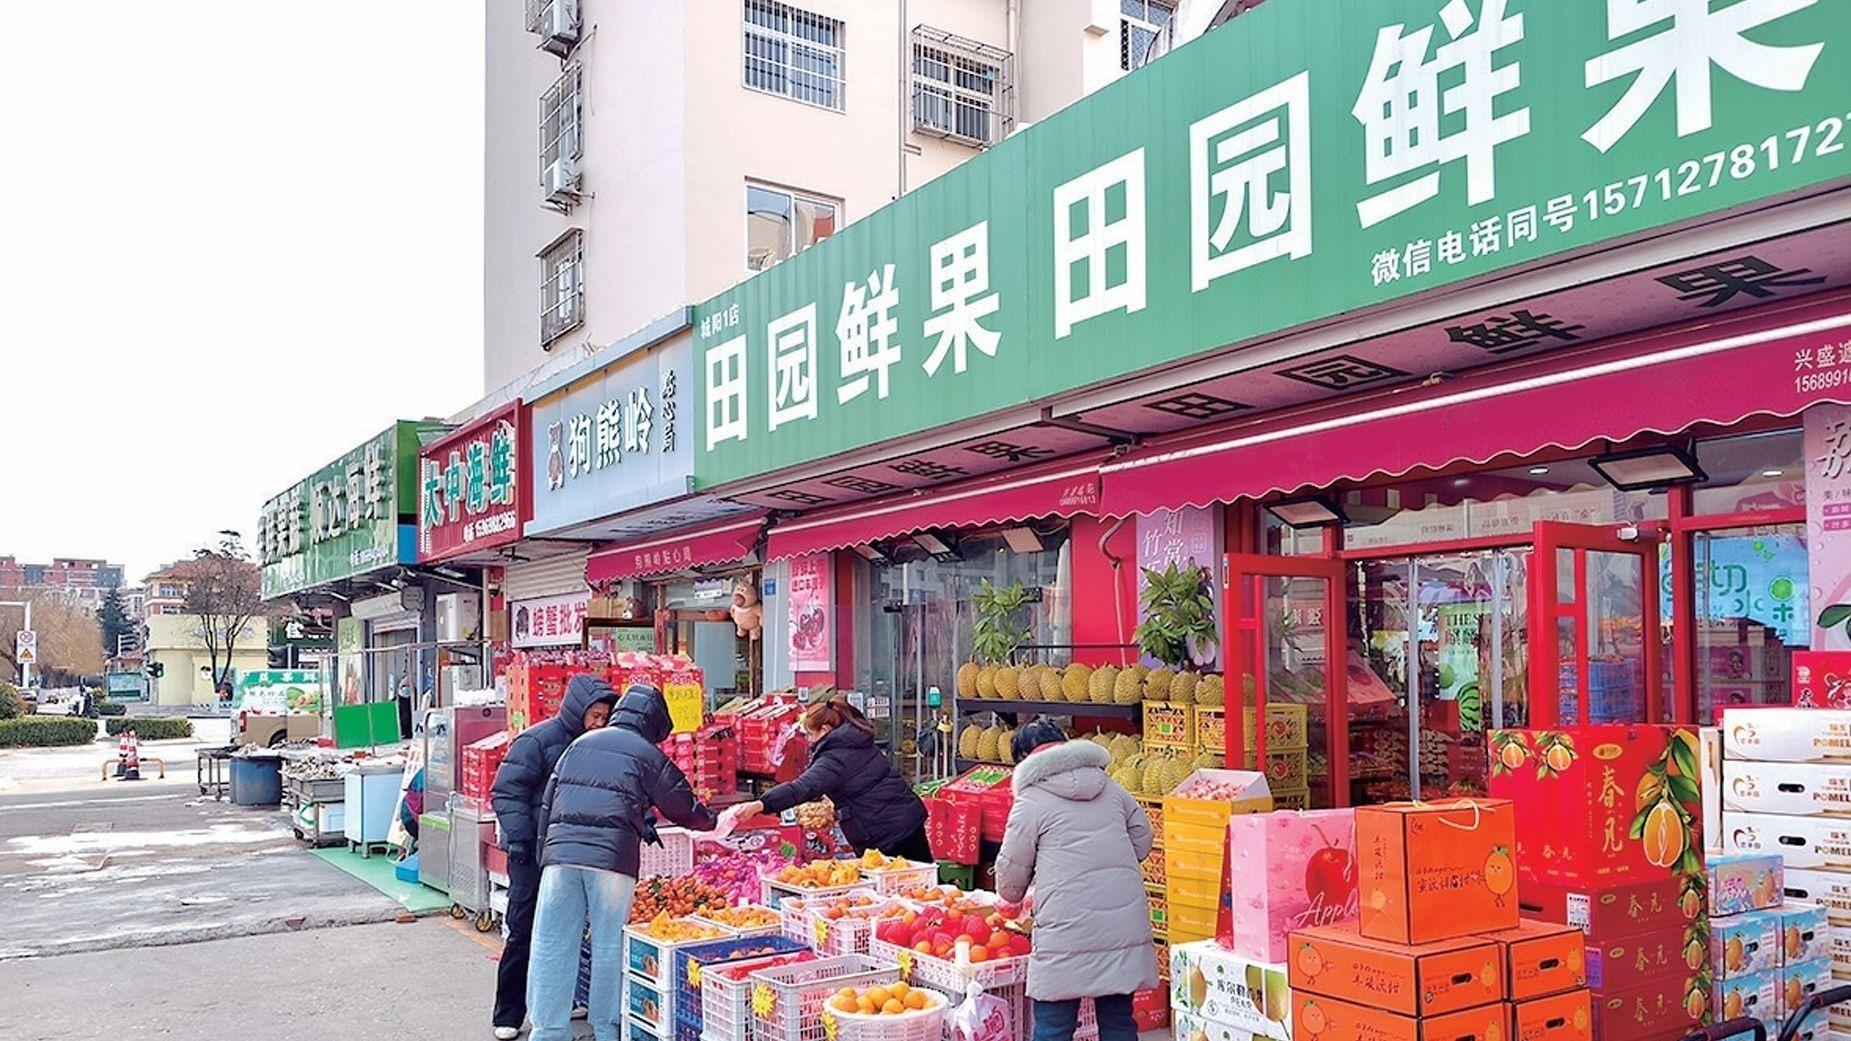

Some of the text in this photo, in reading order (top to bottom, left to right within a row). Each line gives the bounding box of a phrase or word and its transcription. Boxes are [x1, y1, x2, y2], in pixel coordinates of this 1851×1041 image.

[1053, 0, 1826, 340] 田园鲜果
[1371, 113, 1851, 286] 微信电话同号1571278172
[700, 304, 739, 340] 城阳1店
[703, 219, 1002, 450] 田园鲜果
[1143, 256, 1827, 419] 田园鲜果
[1795, 338, 1851, 372] 兴盛遮
[424, 420, 514, 528] 大中海鲜
[568, 388, 653, 479] 狗熊岭
[767, 441, 1055, 504] 田园鲜果
